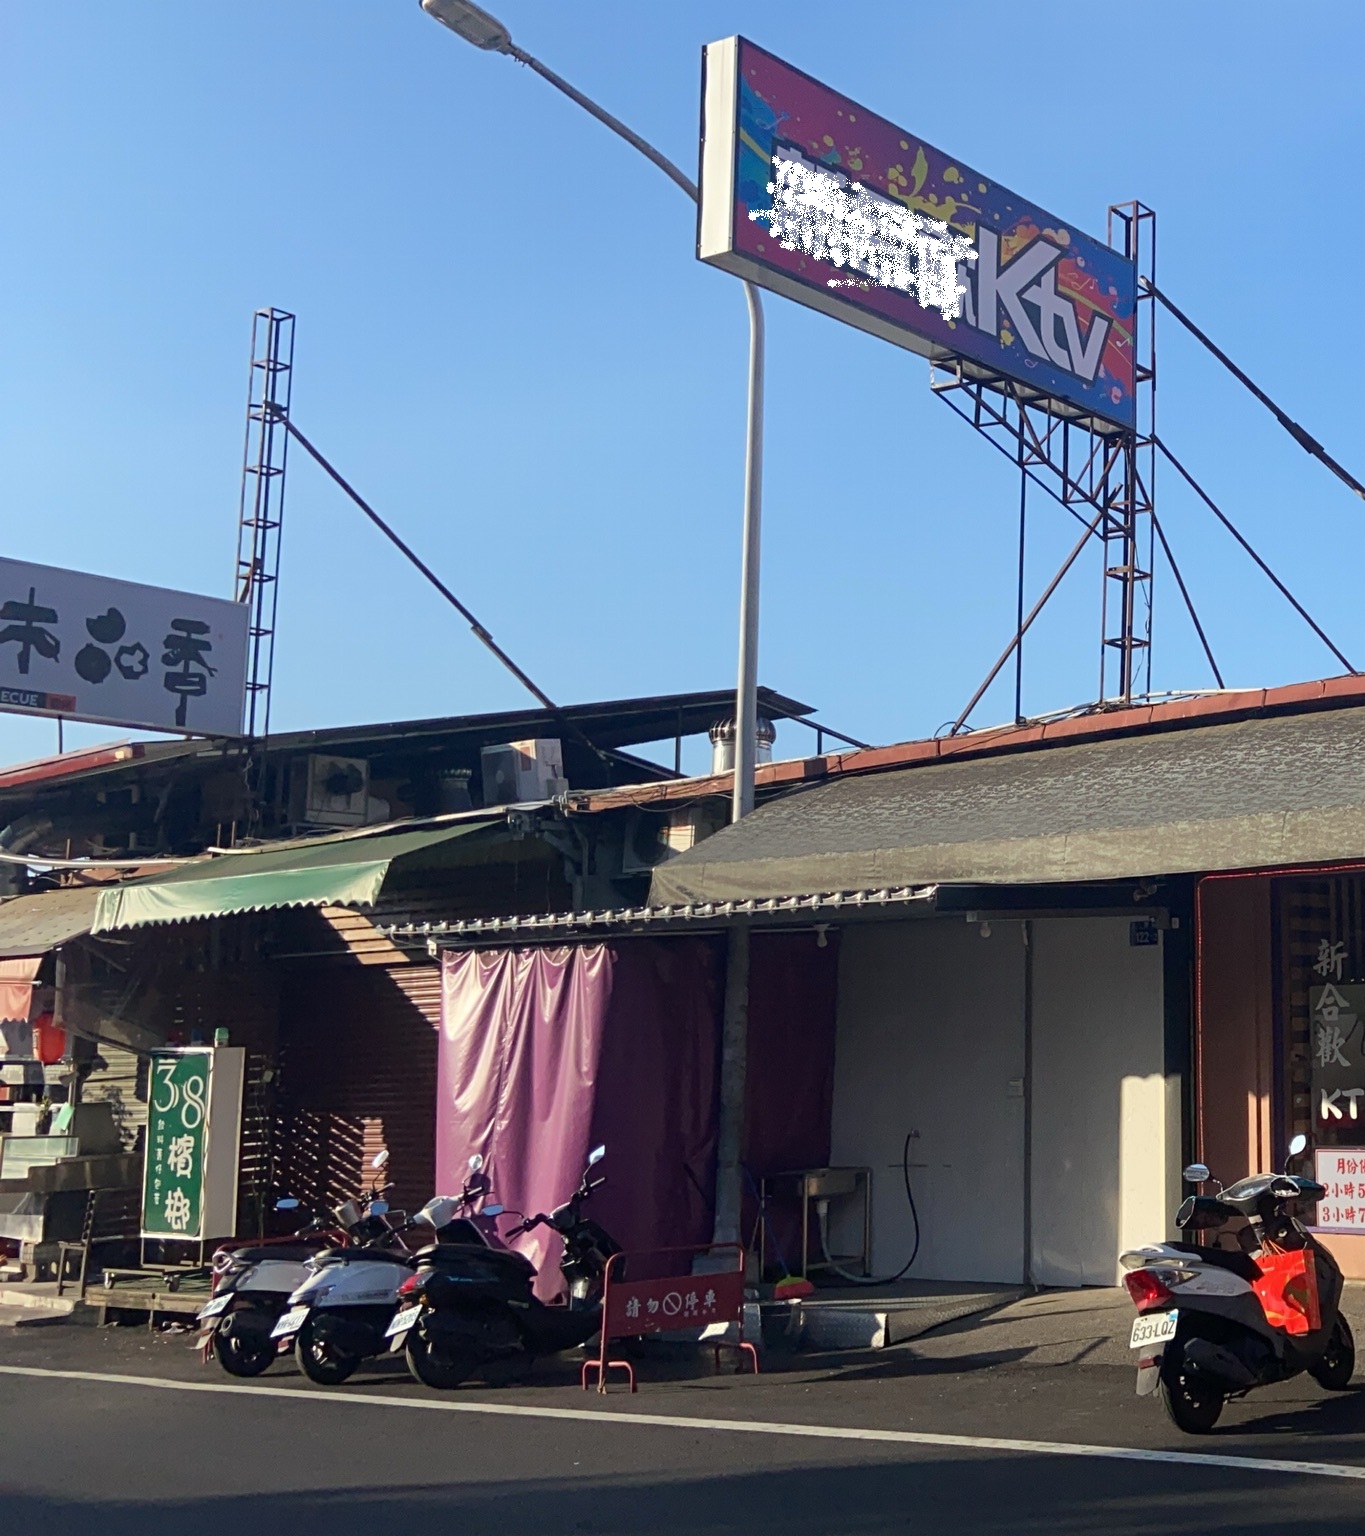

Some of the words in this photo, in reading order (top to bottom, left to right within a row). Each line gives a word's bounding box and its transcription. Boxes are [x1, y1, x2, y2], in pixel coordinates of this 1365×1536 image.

[0, 690, 39, 707] ECUE
[1313, 938, 1352, 1068] 新合歡
[154, 1058, 205, 1129] 38
[164, 1132, 196, 1231] 檳榔
[1132, 1319, 1176, 1343] 633-LQZ
